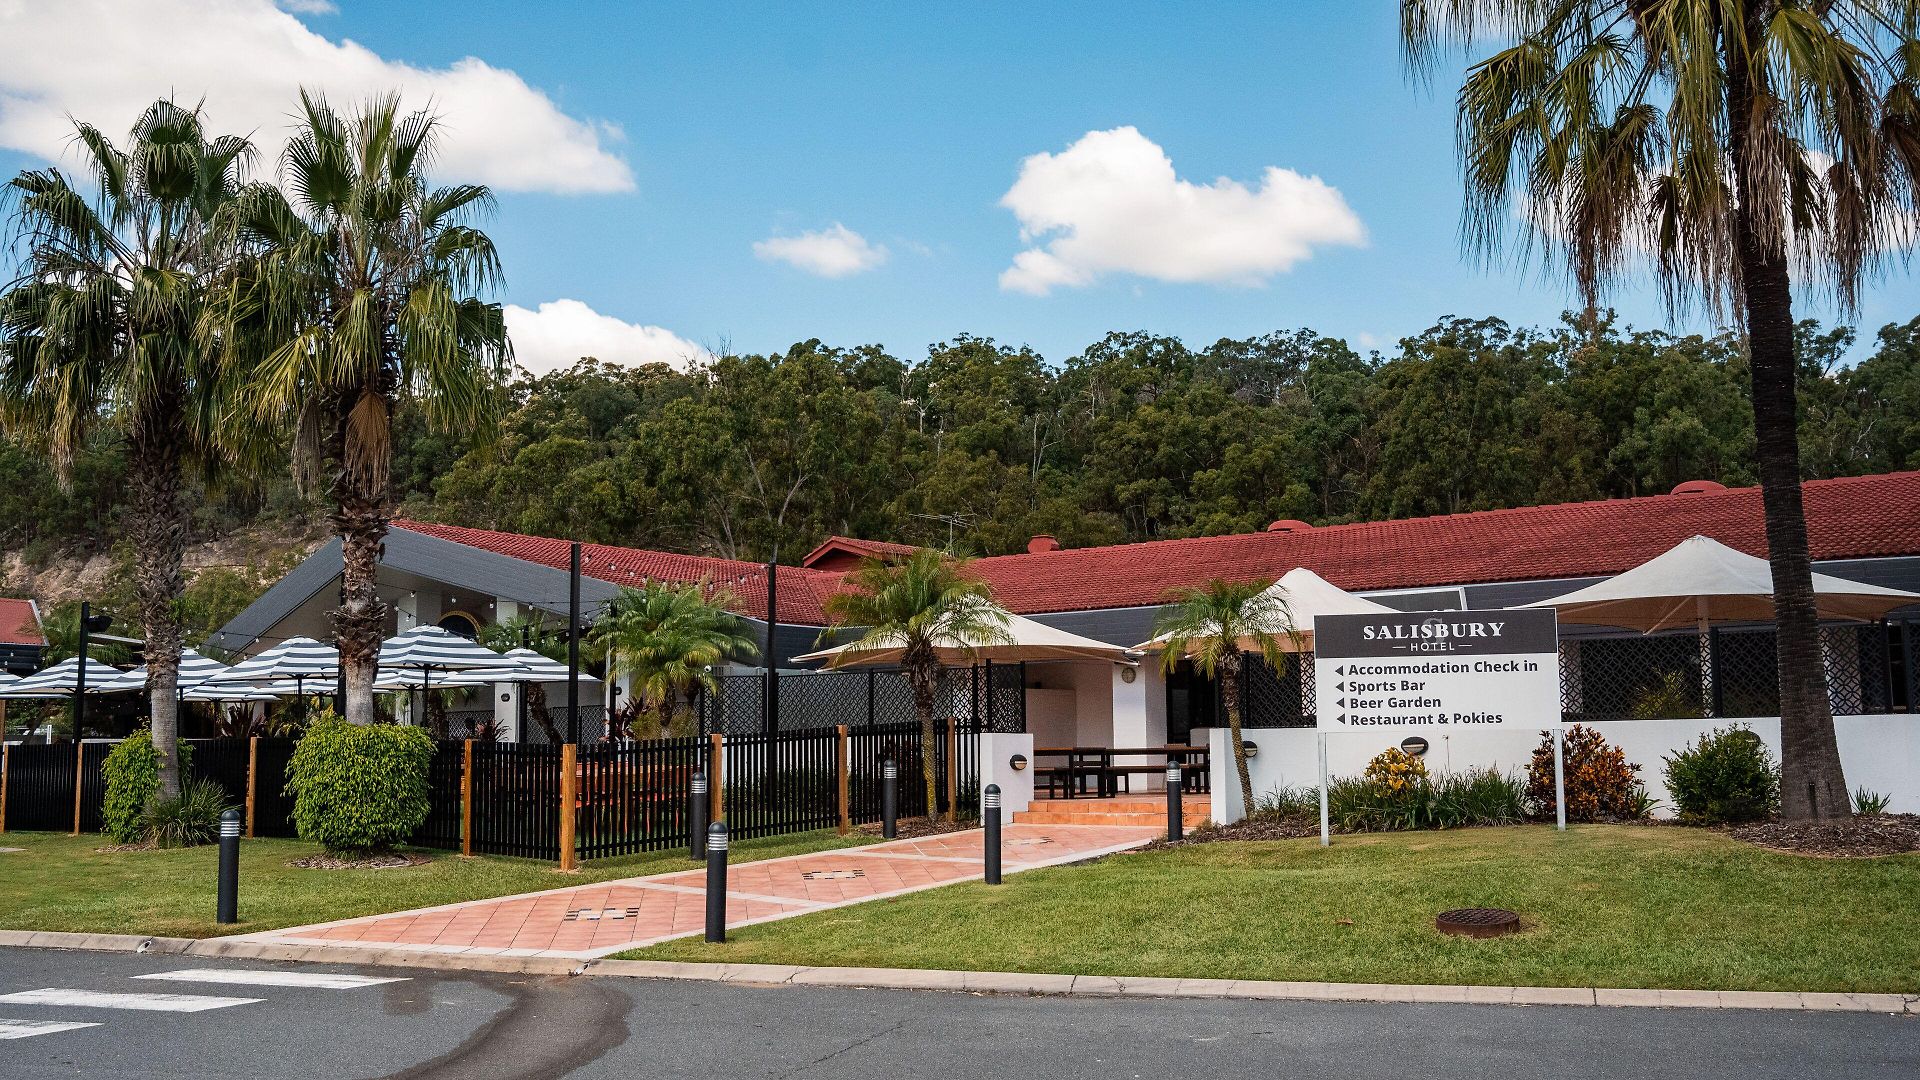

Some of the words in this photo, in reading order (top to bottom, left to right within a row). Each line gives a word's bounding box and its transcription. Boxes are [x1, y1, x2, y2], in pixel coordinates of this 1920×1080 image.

[1363, 622, 1505, 640] SALISBURY
[1410, 642, 1455, 652] HOTEL
[1348, 661, 1470, 675] Accommodation
[1474, 660, 1520, 673] Check
[1523, 659, 1538, 672] in
[1349, 681, 1397, 696] Sports
[1400, 680, 1426, 691] Bar
[1350, 698, 1384, 709] Beer
[1387, 696, 1442, 708] Garden
[1350, 714, 1434, 726] Restaurant
[1437, 713, 1449, 724] &
[1453, 711, 1503, 724] Pokies
